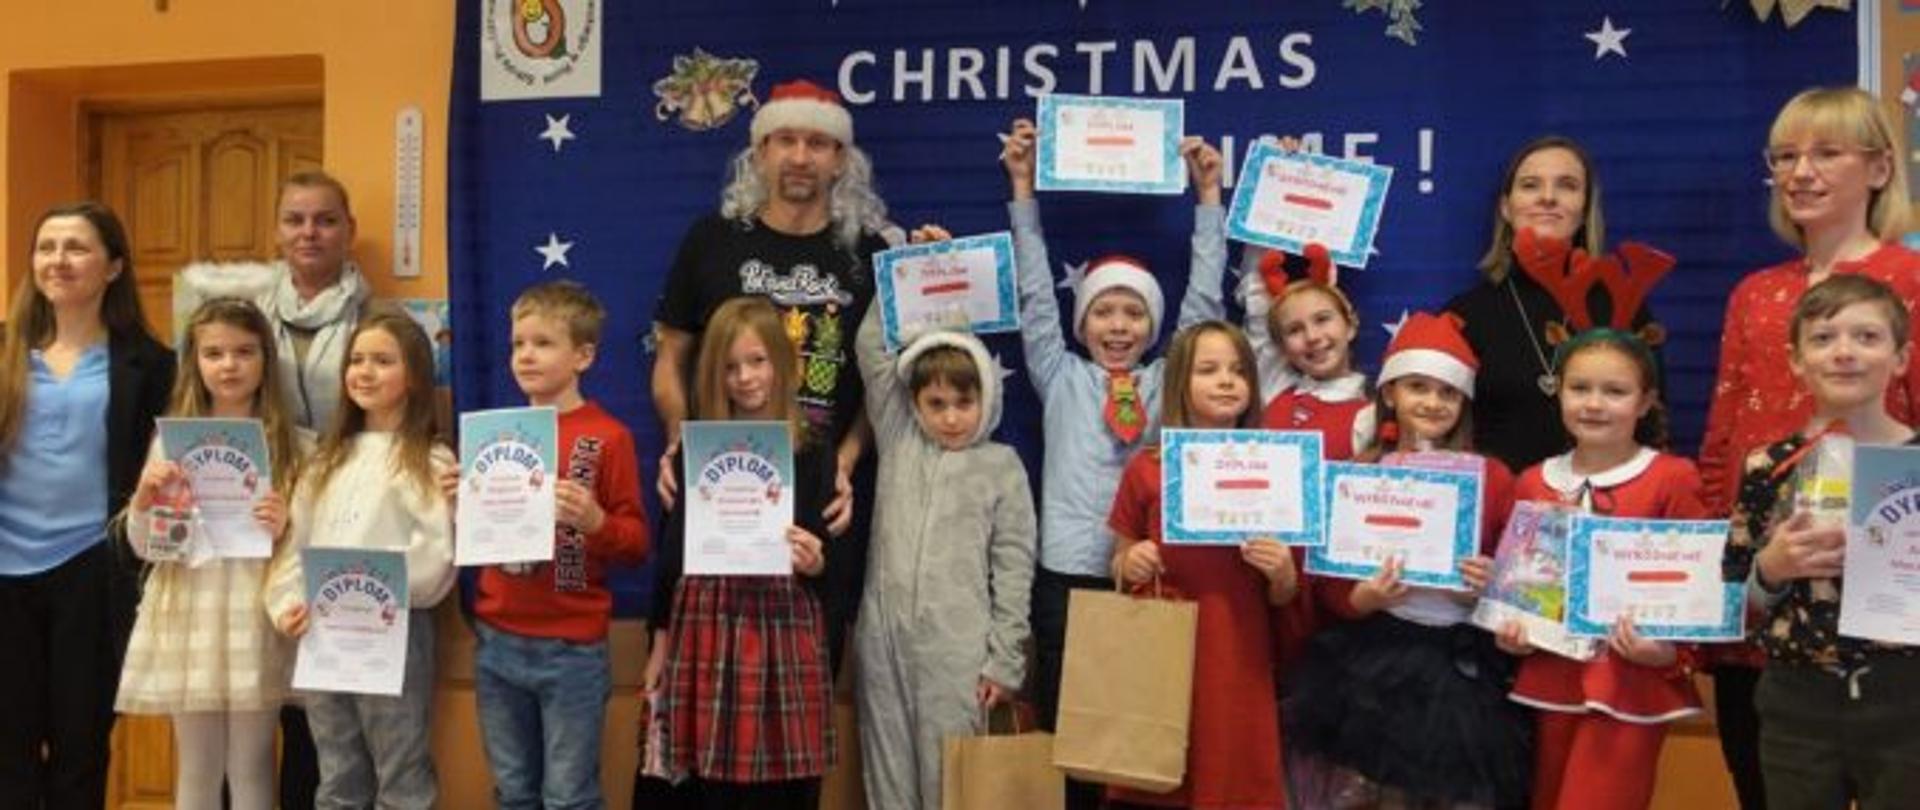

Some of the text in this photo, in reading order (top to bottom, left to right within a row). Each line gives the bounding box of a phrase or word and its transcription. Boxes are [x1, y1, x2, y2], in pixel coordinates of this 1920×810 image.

[838, 33, 1316, 103] CHRISTMAS
[475, 445, 540, 474] DYPLOM
[704, 455, 775, 484] DYPLOM
[323, 578, 390, 605] DYPLOM
